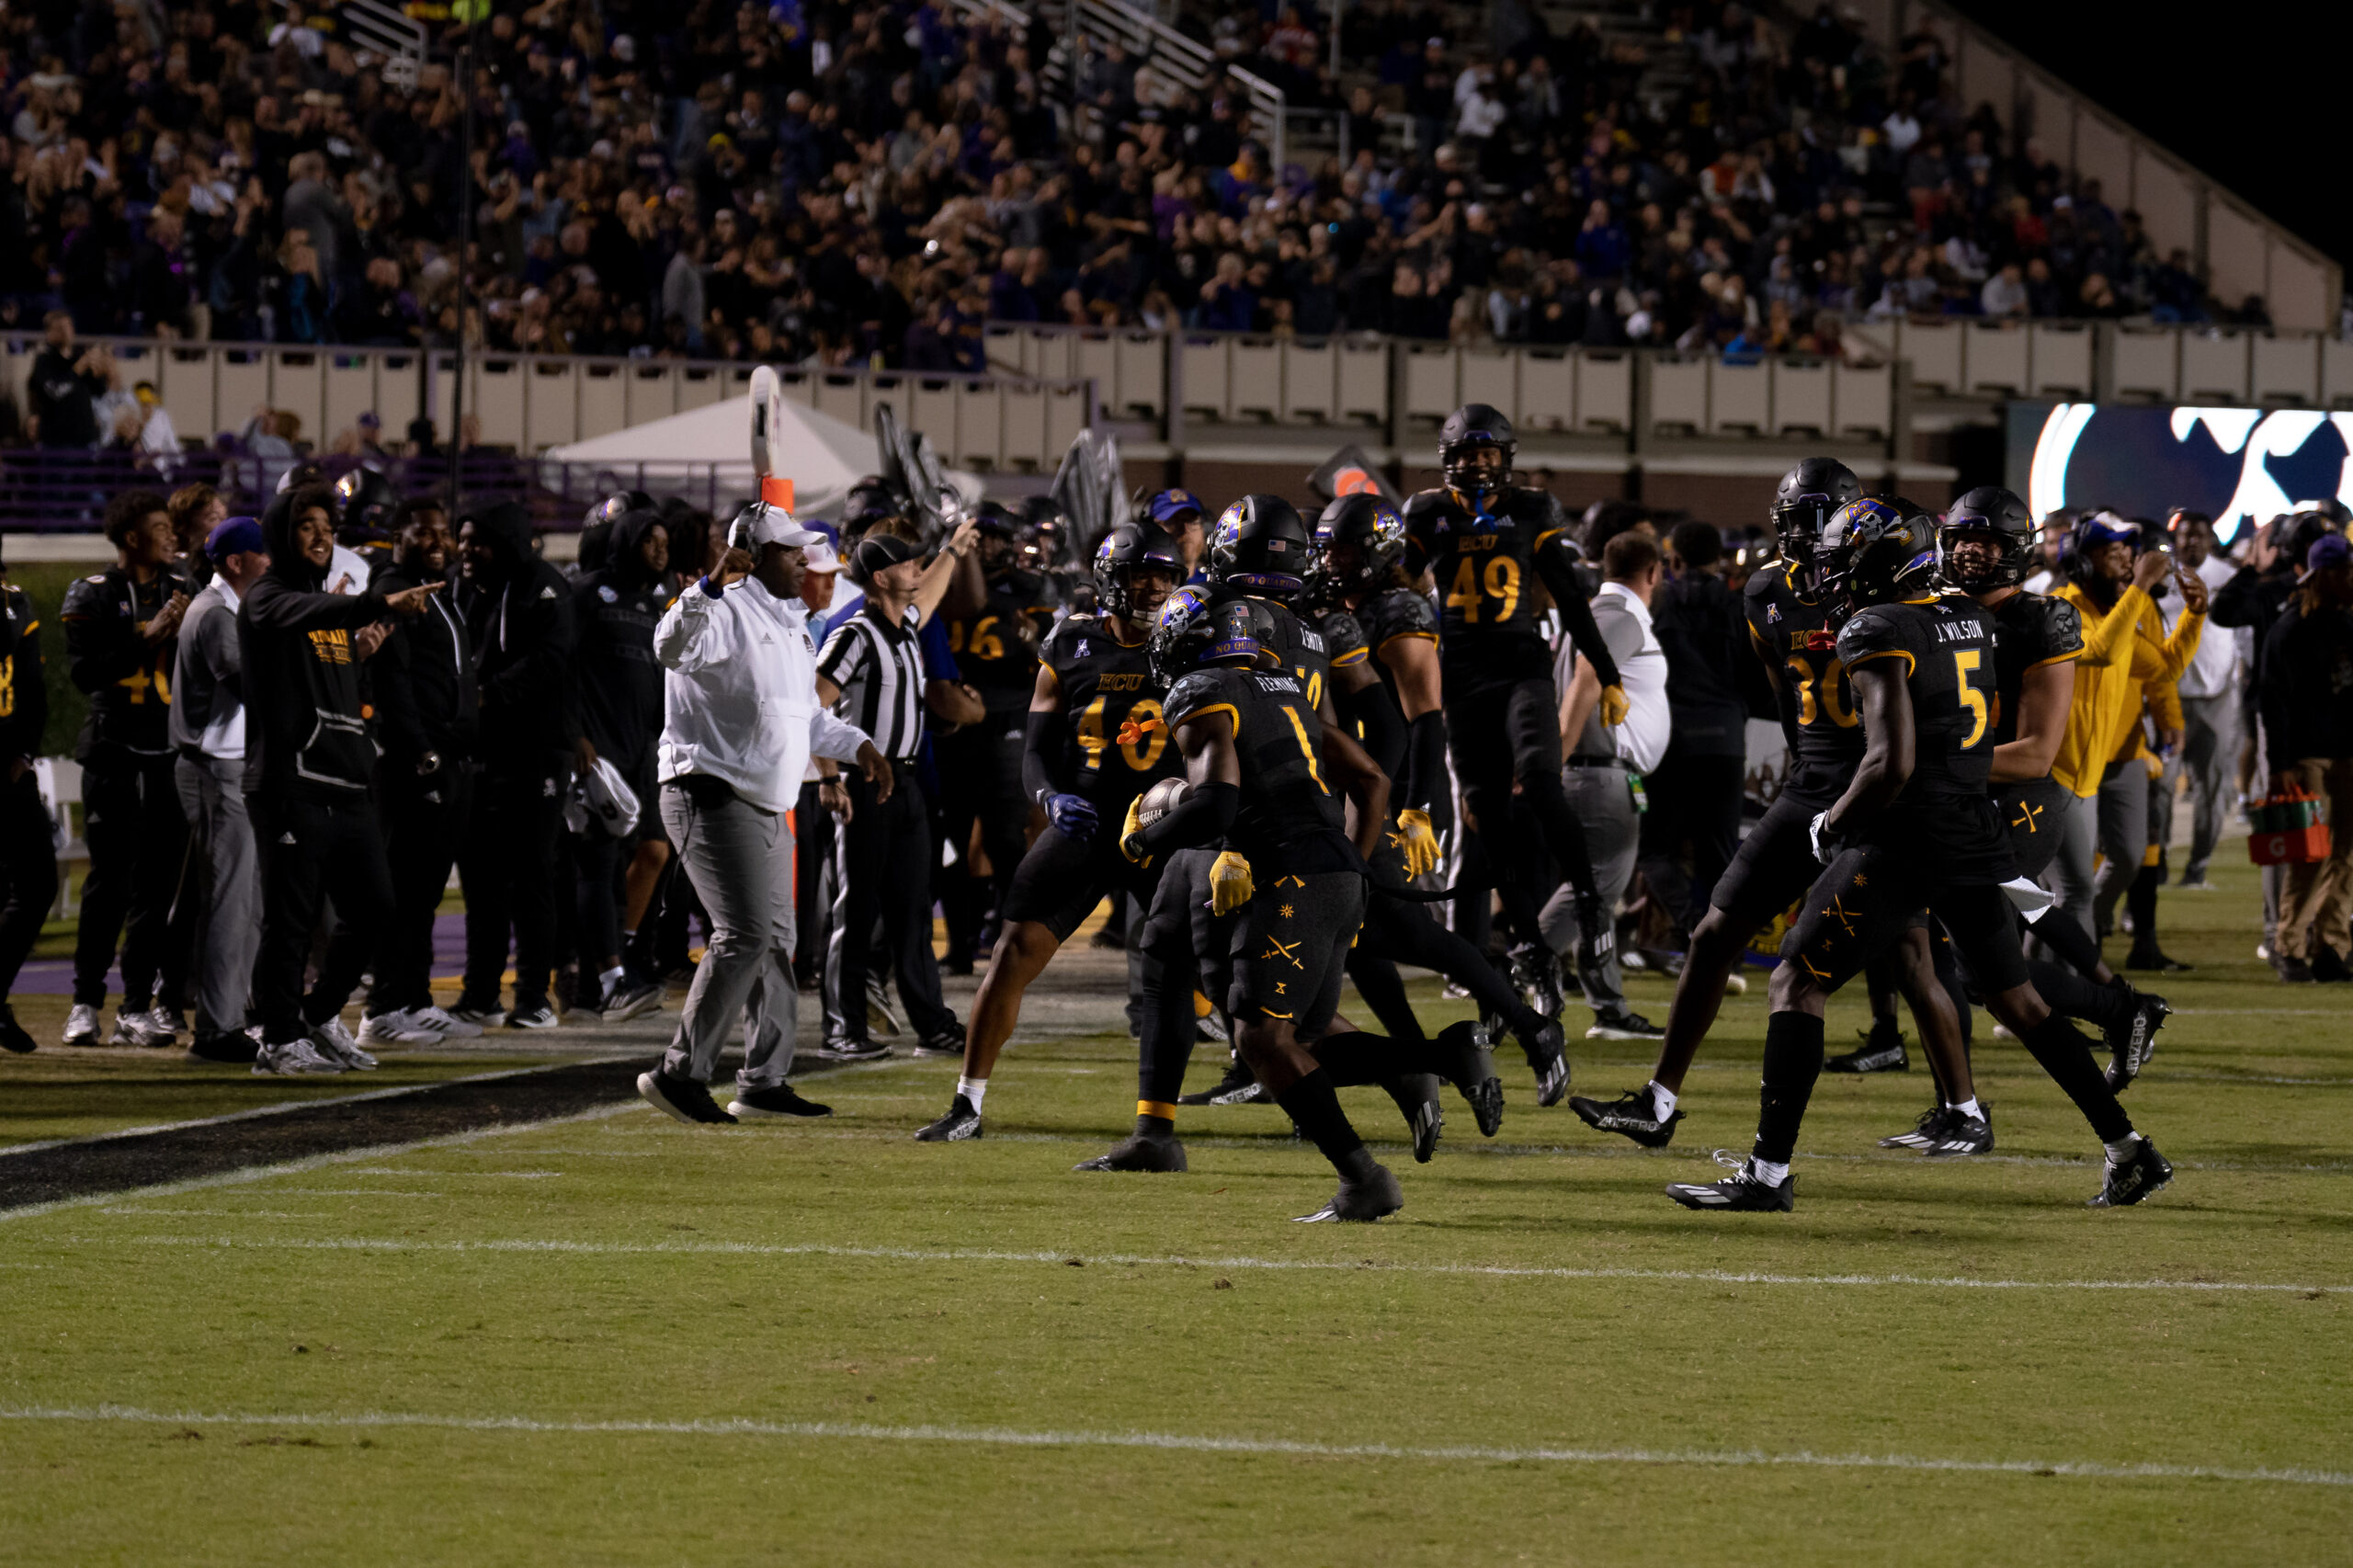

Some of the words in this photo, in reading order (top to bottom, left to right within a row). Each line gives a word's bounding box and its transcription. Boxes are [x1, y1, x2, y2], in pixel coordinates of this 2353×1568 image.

[1457, 534, 1499, 553] ECU
[1446, 555, 1521, 624] 49
[1214, 643, 1231, 655] NO
[1096, 673, 1146, 692] ECU
[1255, 676, 1301, 693] FLEMING
[1785, 654, 1859, 729] 30
[1952, 647, 1988, 750] 5
[1076, 694, 1170, 772] 40
[1278, 704, 1332, 797] 1
[2268, 835, 2287, 858] G
